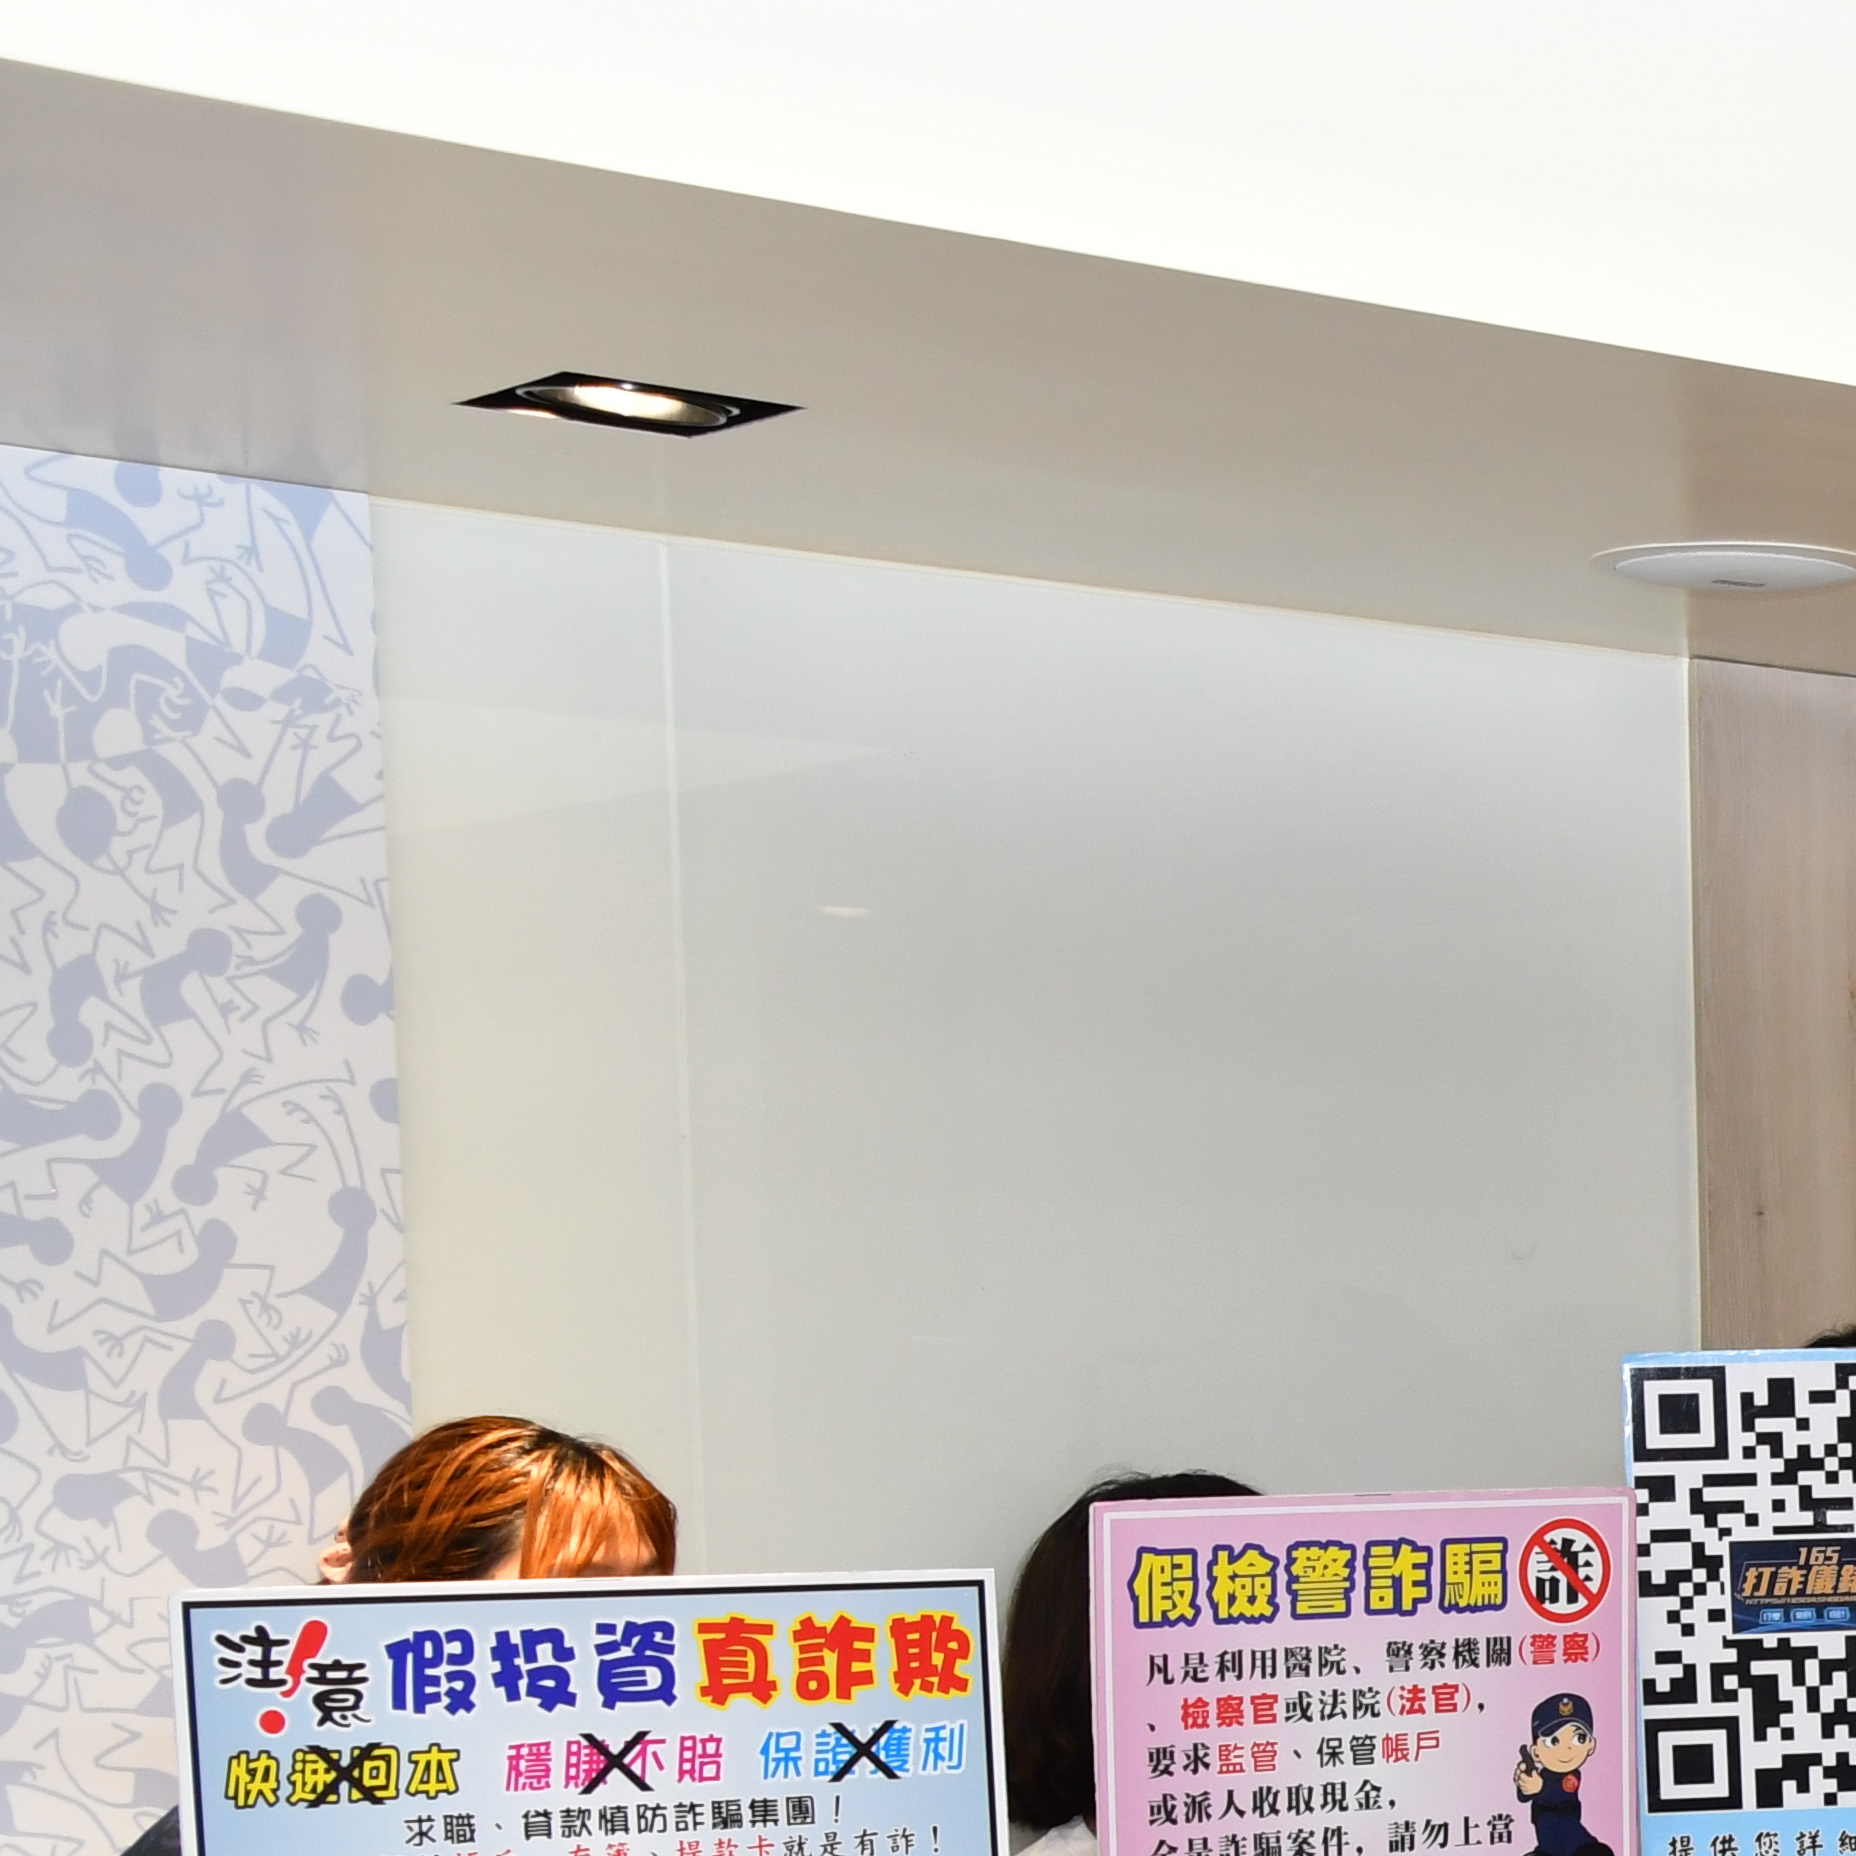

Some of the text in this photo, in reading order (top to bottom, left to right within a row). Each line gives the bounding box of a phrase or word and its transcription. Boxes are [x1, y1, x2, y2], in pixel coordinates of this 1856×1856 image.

[1129, 1536, 1508, 1629] 假檢警詐騙
[1799, 1546, 1841, 1565] 165
[1145, 1631, 1601, 1688] 凡是利用醫院、警察機關(警察)
[225, 1720, 967, 1810] 快速回本 穩賺不賠 保證獲利
[1146, 1729, 1442, 1779] 要求監管、保管帳戶
[403, 1794, 845, 1848] 求職、貸款慎防詐騙集團！
[1148, 1778, 1398, 1827] 或派人收取現金，
